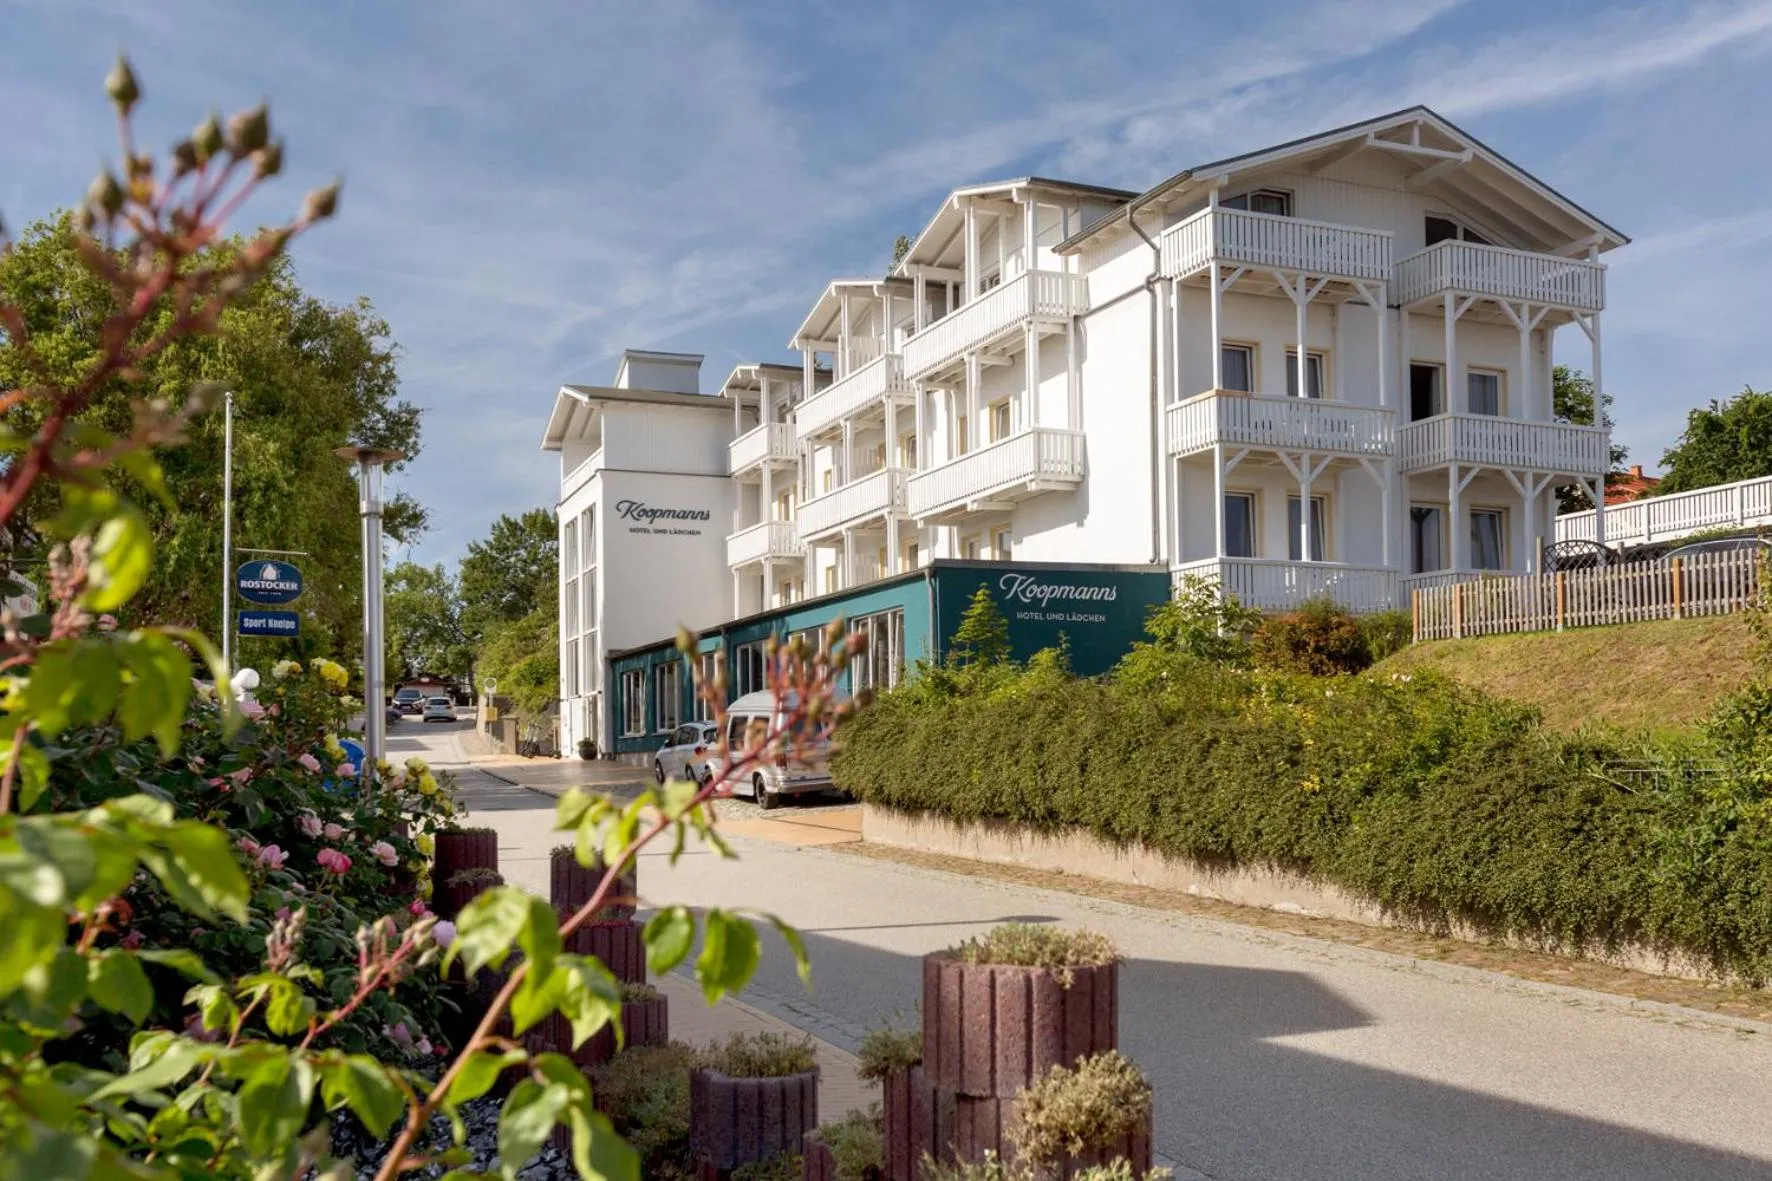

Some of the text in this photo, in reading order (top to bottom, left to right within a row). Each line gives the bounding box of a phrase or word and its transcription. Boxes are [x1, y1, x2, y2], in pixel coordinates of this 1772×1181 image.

[615, 499, 711, 525] Koopmanns
[629, 527, 652, 535] HOTEL
[240, 580, 298, 591] ROSTOCKER
[999, 573, 1118, 608] Koopmanns
[243, 617, 296, 629] Sport Kneipe
[1016, 611, 1106, 623] HOTEL UND LÄDCHEN
